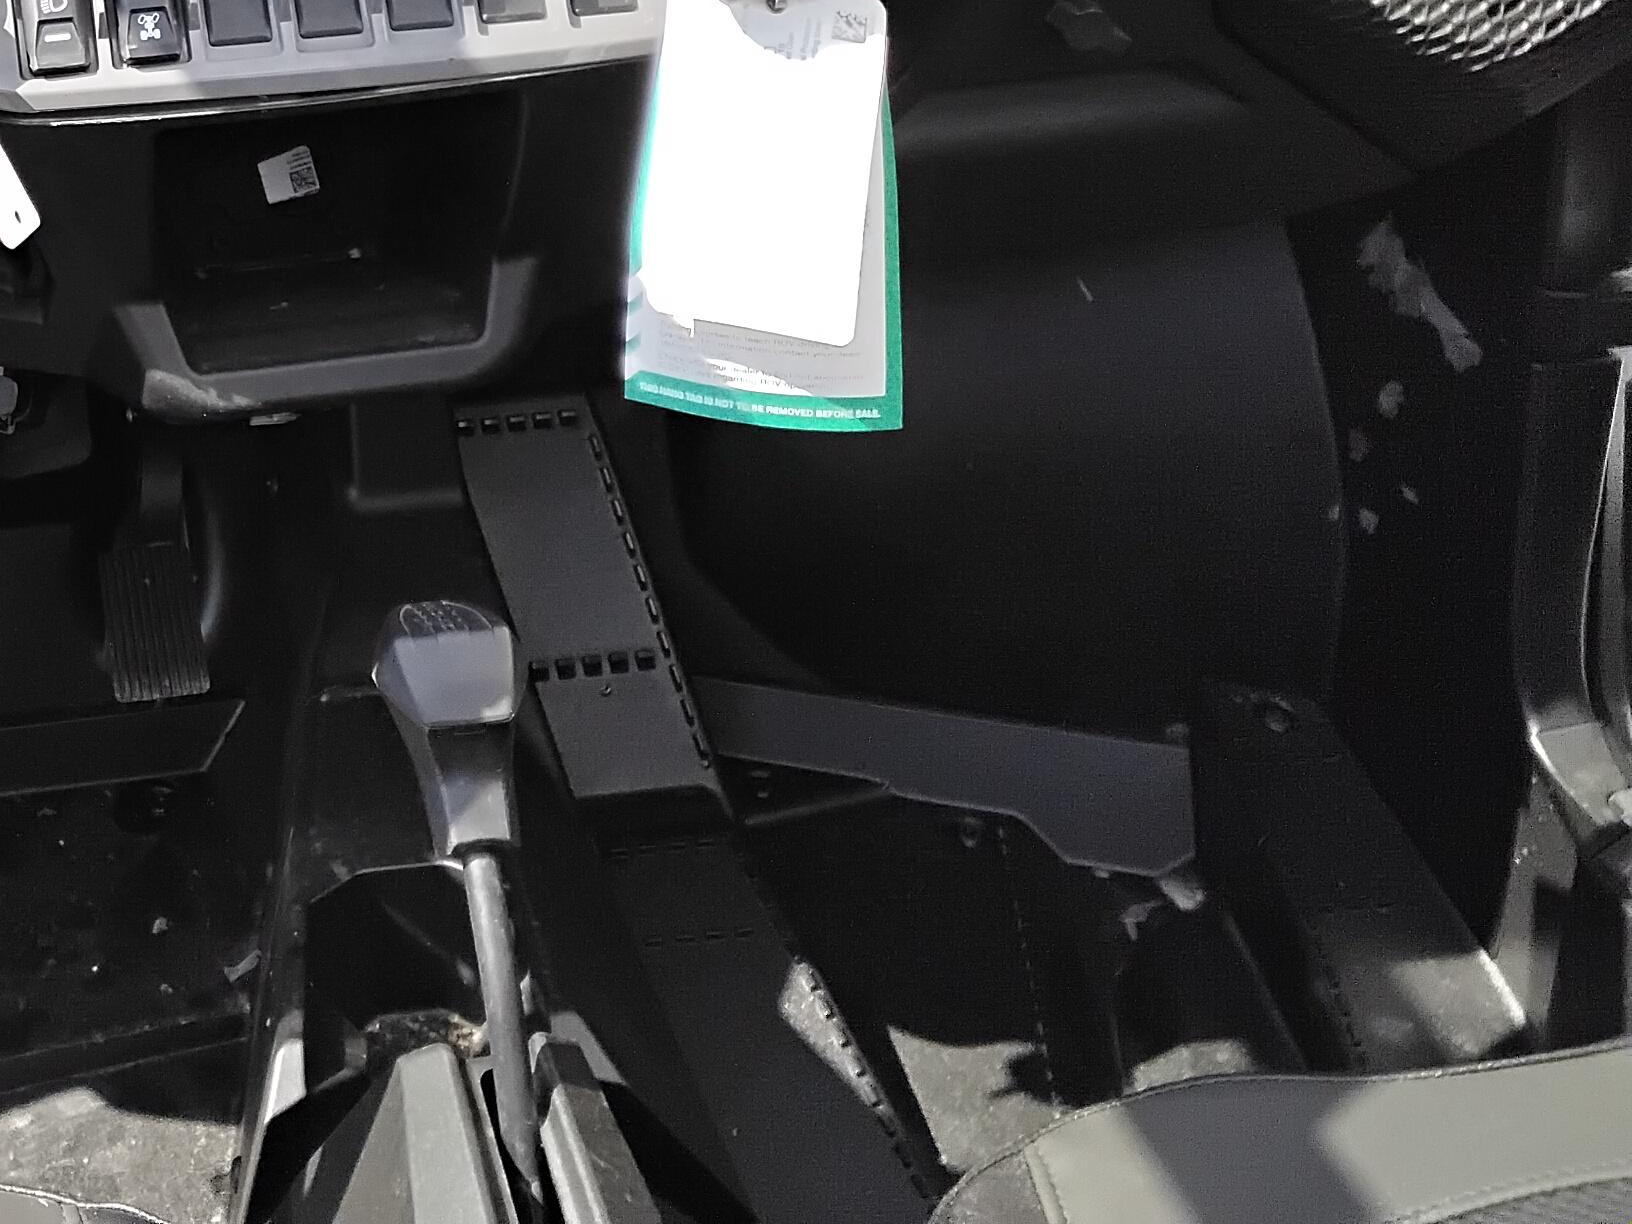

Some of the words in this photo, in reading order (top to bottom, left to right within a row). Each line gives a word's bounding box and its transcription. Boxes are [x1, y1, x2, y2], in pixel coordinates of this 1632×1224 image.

[751, 404, 764, 413] BE
[765, 405, 814, 417] REMOVED
[815, 409, 854, 419] BEFORE
